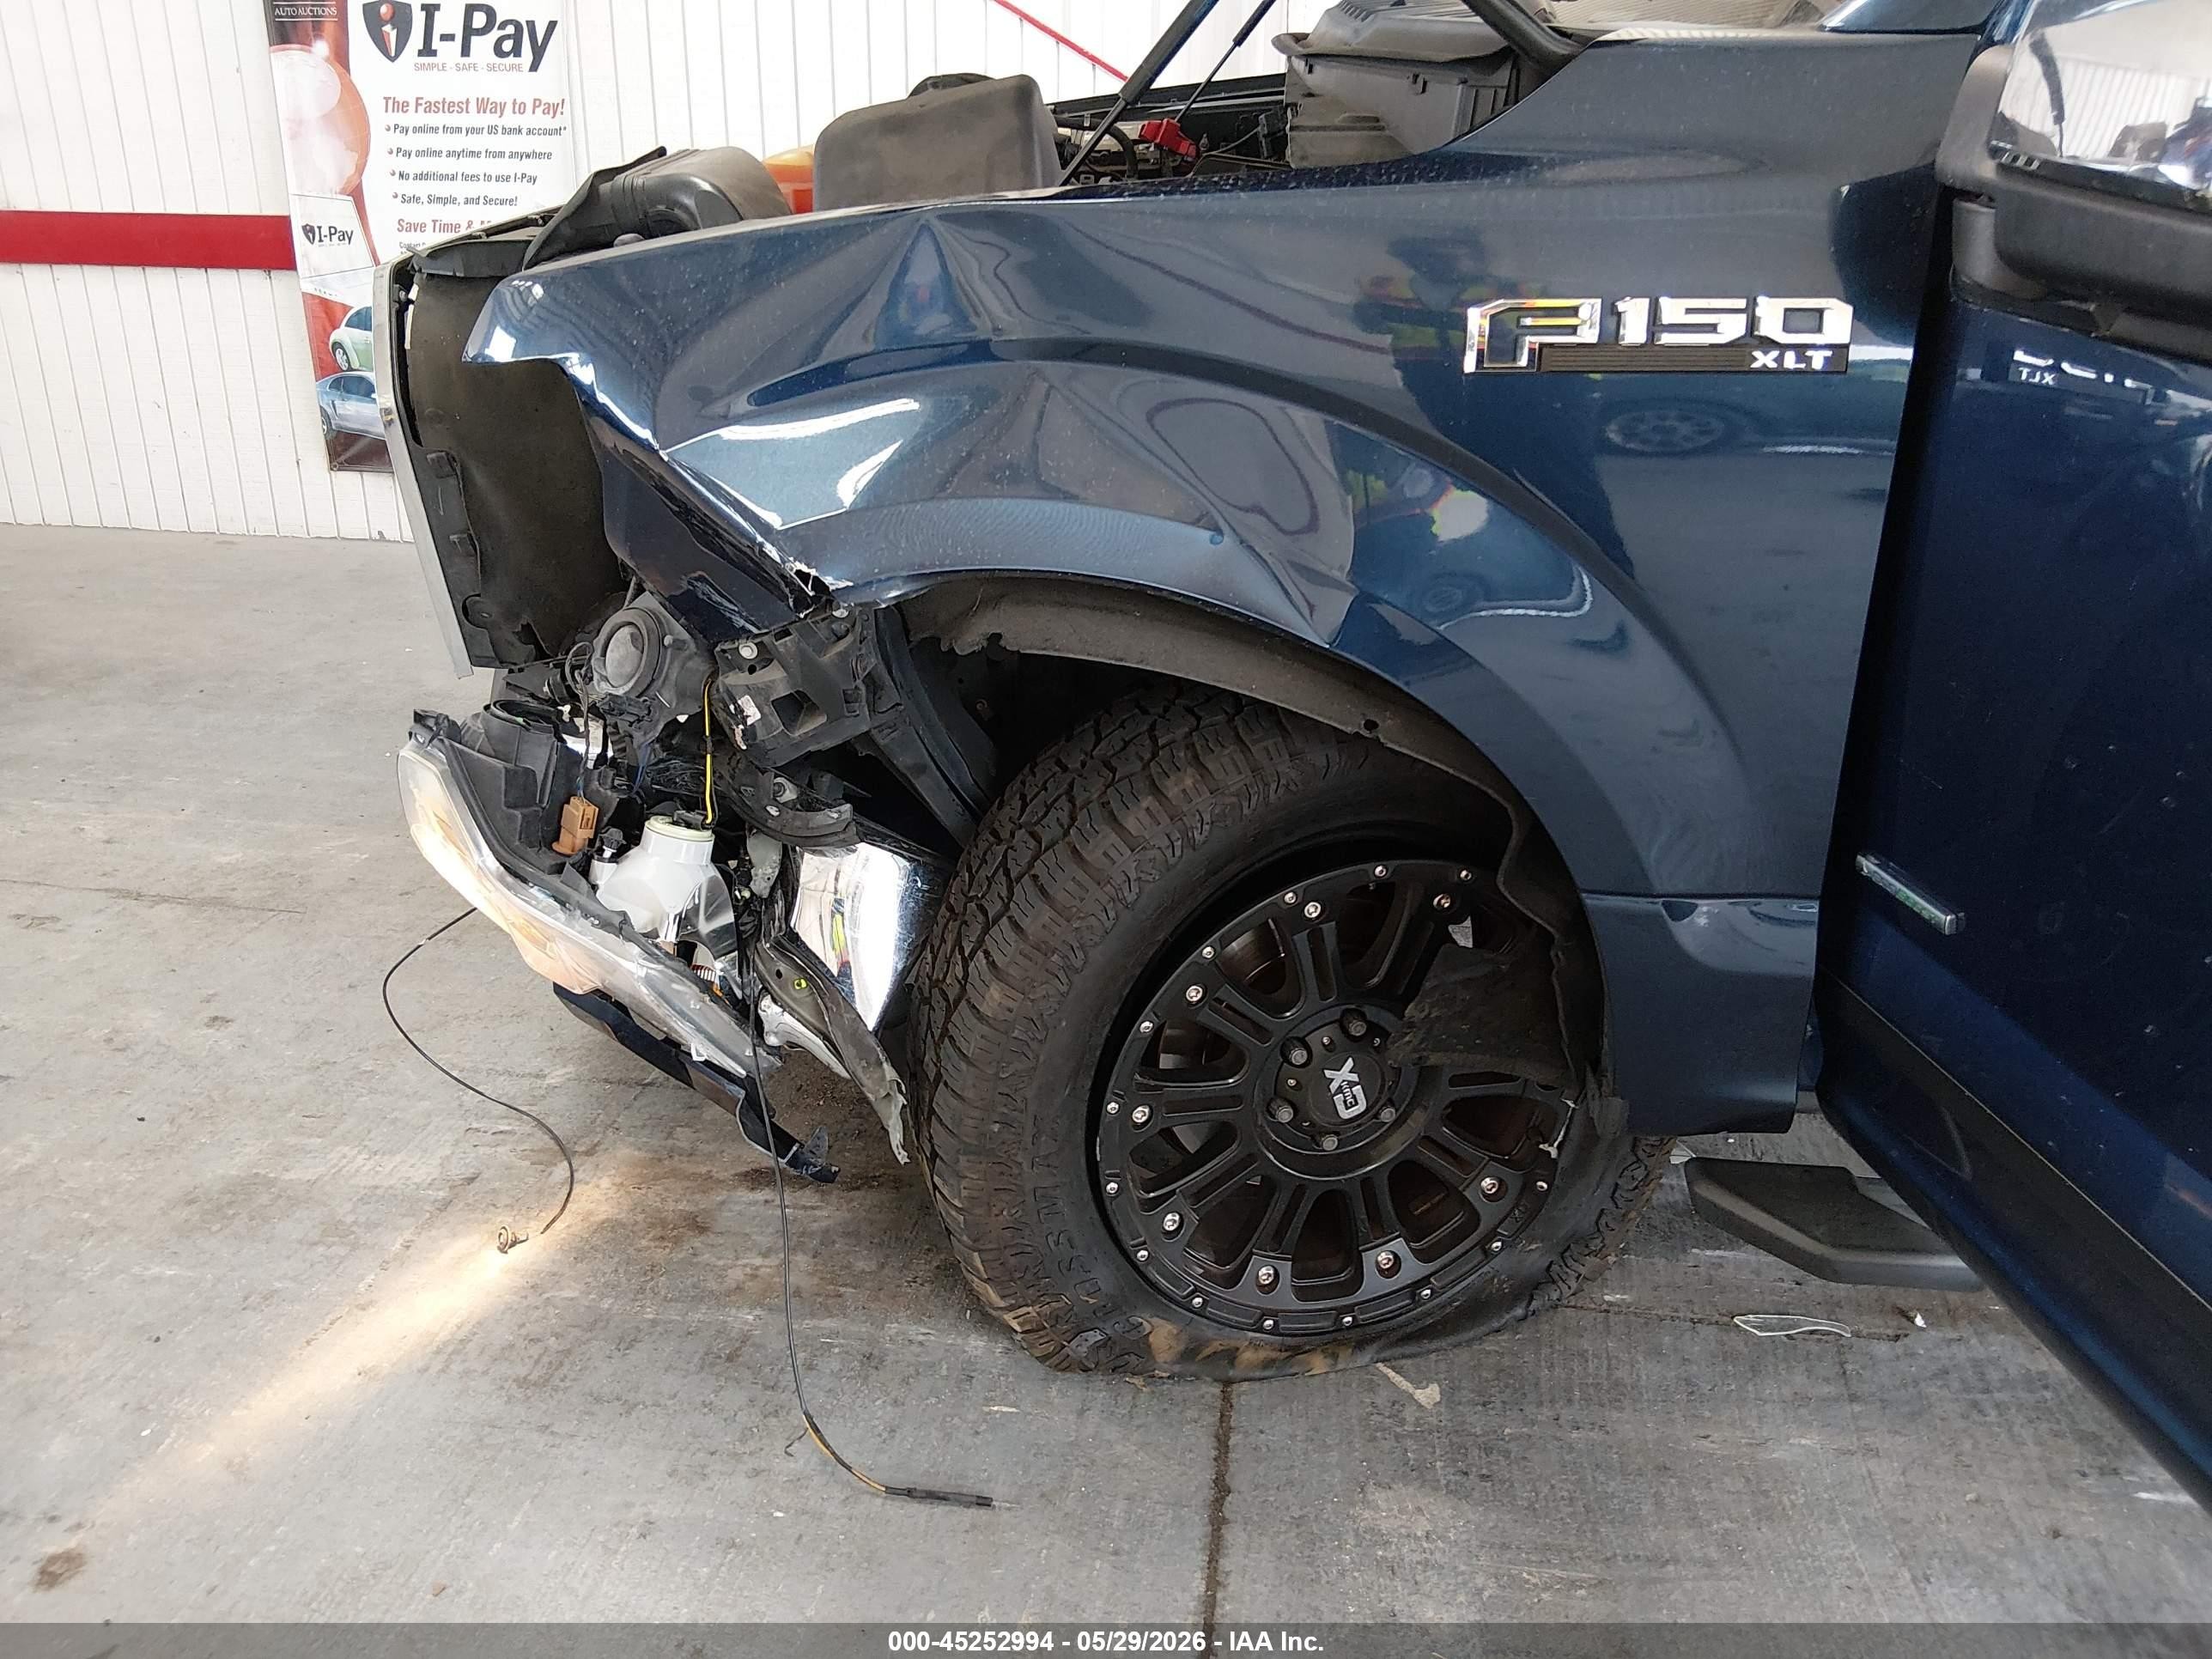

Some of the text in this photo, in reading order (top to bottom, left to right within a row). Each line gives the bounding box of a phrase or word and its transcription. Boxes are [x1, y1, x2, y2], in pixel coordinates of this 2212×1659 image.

[275, 7, 337, 15] AUTO AUCTIONS
[416, 3, 558, 73] I-Pay
[414, 63, 447, 71] SIMPLE
[454, 63, 479, 72] SAFE
[486, 63, 524, 73] SECURE
[383, 96, 565, 119] The Fastest Way to Pay!
[393, 124, 410, 136] Pay
[412, 124, 440, 134] online
[442, 124, 463, 135] from
[465, 126, 485, 137] your
[487, 125, 499, 135] US
[501, 125, 523, 136] bank
[396, 147, 553, 161] Pay online anytime from anywhere
[398, 170, 538, 185] No additional fees to use I-Pay
[400, 193, 519, 206] Safe, Simple, and Secure!
[397, 218, 427, 233] Save
[431, 219, 461, 234] Time
[317, 225, 354, 246] I-Pay
[1750, 349, 1832, 370] XLT
